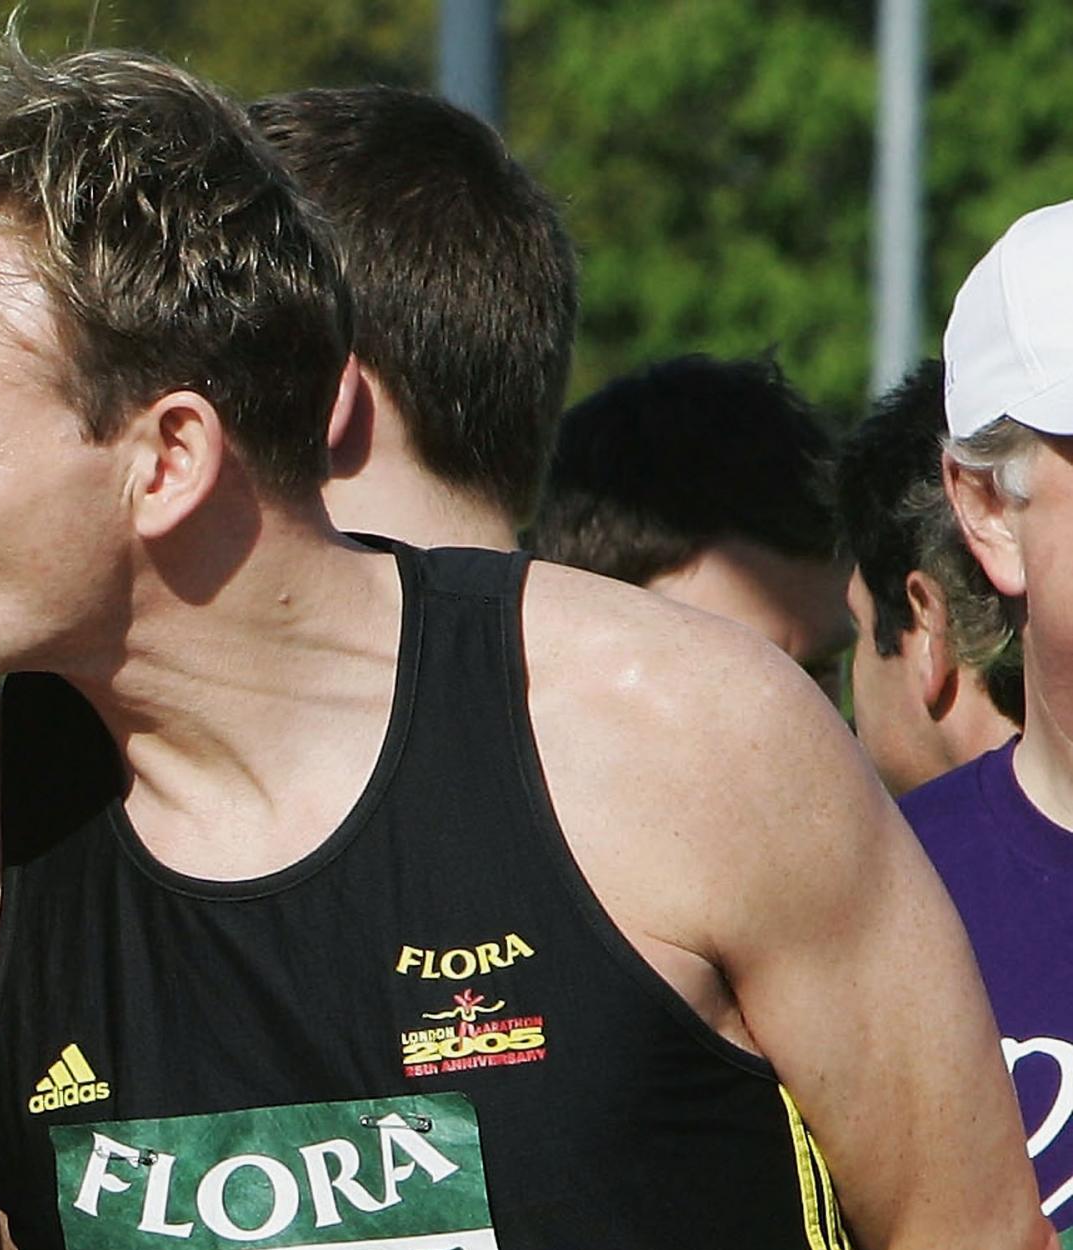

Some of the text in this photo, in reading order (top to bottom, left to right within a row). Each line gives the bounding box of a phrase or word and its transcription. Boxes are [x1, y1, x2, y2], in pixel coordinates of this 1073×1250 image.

[396, 933, 535, 980] FLORA
[401, 1026, 456, 1045] LONDON
[402, 1027, 546, 1065] 2005
[440, 1047, 547, 1073] ANNIVERSARY
[29, 1081, 110, 1114] adidas
[73, 1112, 460, 1241] FLORA
